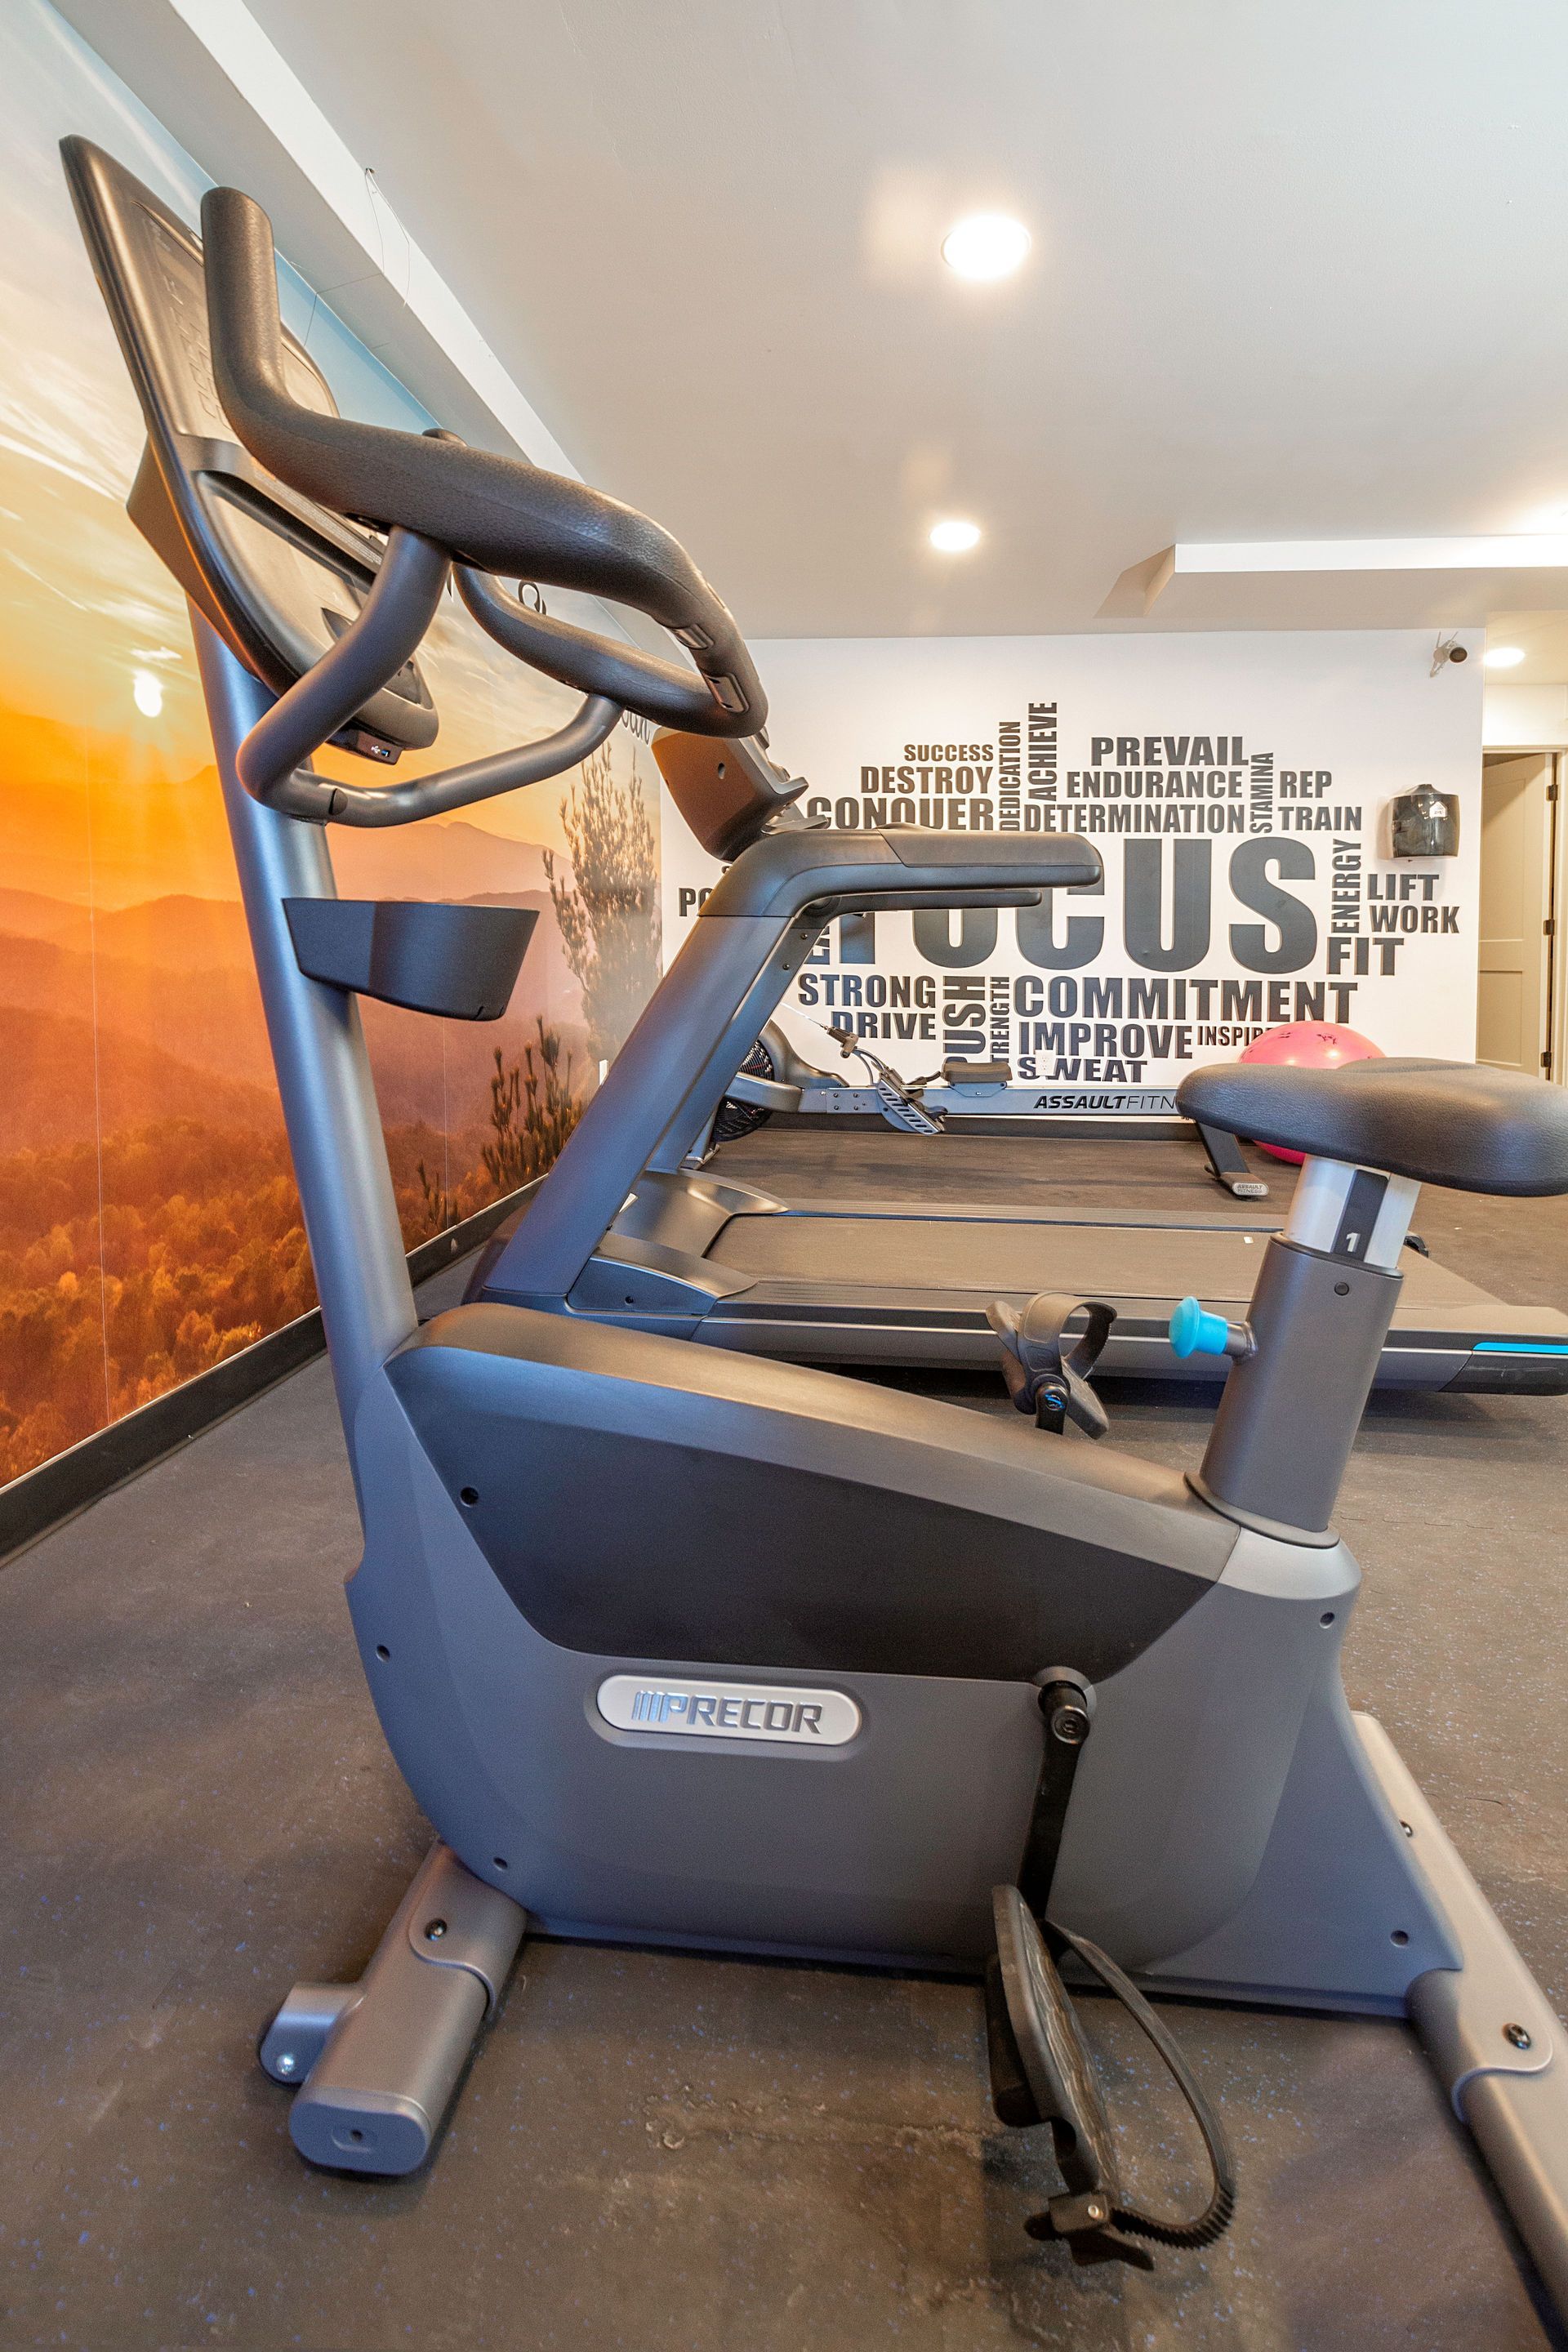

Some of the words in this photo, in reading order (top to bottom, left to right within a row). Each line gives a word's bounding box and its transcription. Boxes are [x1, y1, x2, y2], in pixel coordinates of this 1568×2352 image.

[904, 744, 994, 762] SUCCESS
[1027, 702, 1057, 802] ACHIEVE
[1090, 736, 1249, 767] PREVAIL
[861, 765, 993, 795] DESTROY
[998, 722, 1021, 831] DEDICATION
[1066, 770, 1243, 799] ENDURANCE
[1280, 770, 1332, 799] REP
[1250, 752, 1274, 834] STAMINA
[807, 796, 994, 831] CONQUER
[1024, 804, 1245, 833] DETERMINATION
[1278, 806, 1362, 831] TRAIN
[1331, 838, 1361, 934] ENERGY
[1367, 874, 1440, 902] LIFT
[1370, 906, 1460, 934] WORK
[1326, 937, 1405, 976] FIT
[798, 973, 937, 1009] STRONG
[1013, 976, 1358, 1024] COMMITMENT
[831, 1011, 937, 1041] DRIVE
[990, 977, 1010, 1063] TRENGTH
[1019, 1022, 1193, 1059] IMPROVE
[1197, 1026, 1273, 1047] INSPI
[1018, 1057, 1148, 1084] SWEAT
[1346, 1232, 1361, 1253] 1
[660, 1692, 824, 1735] PRECOR
